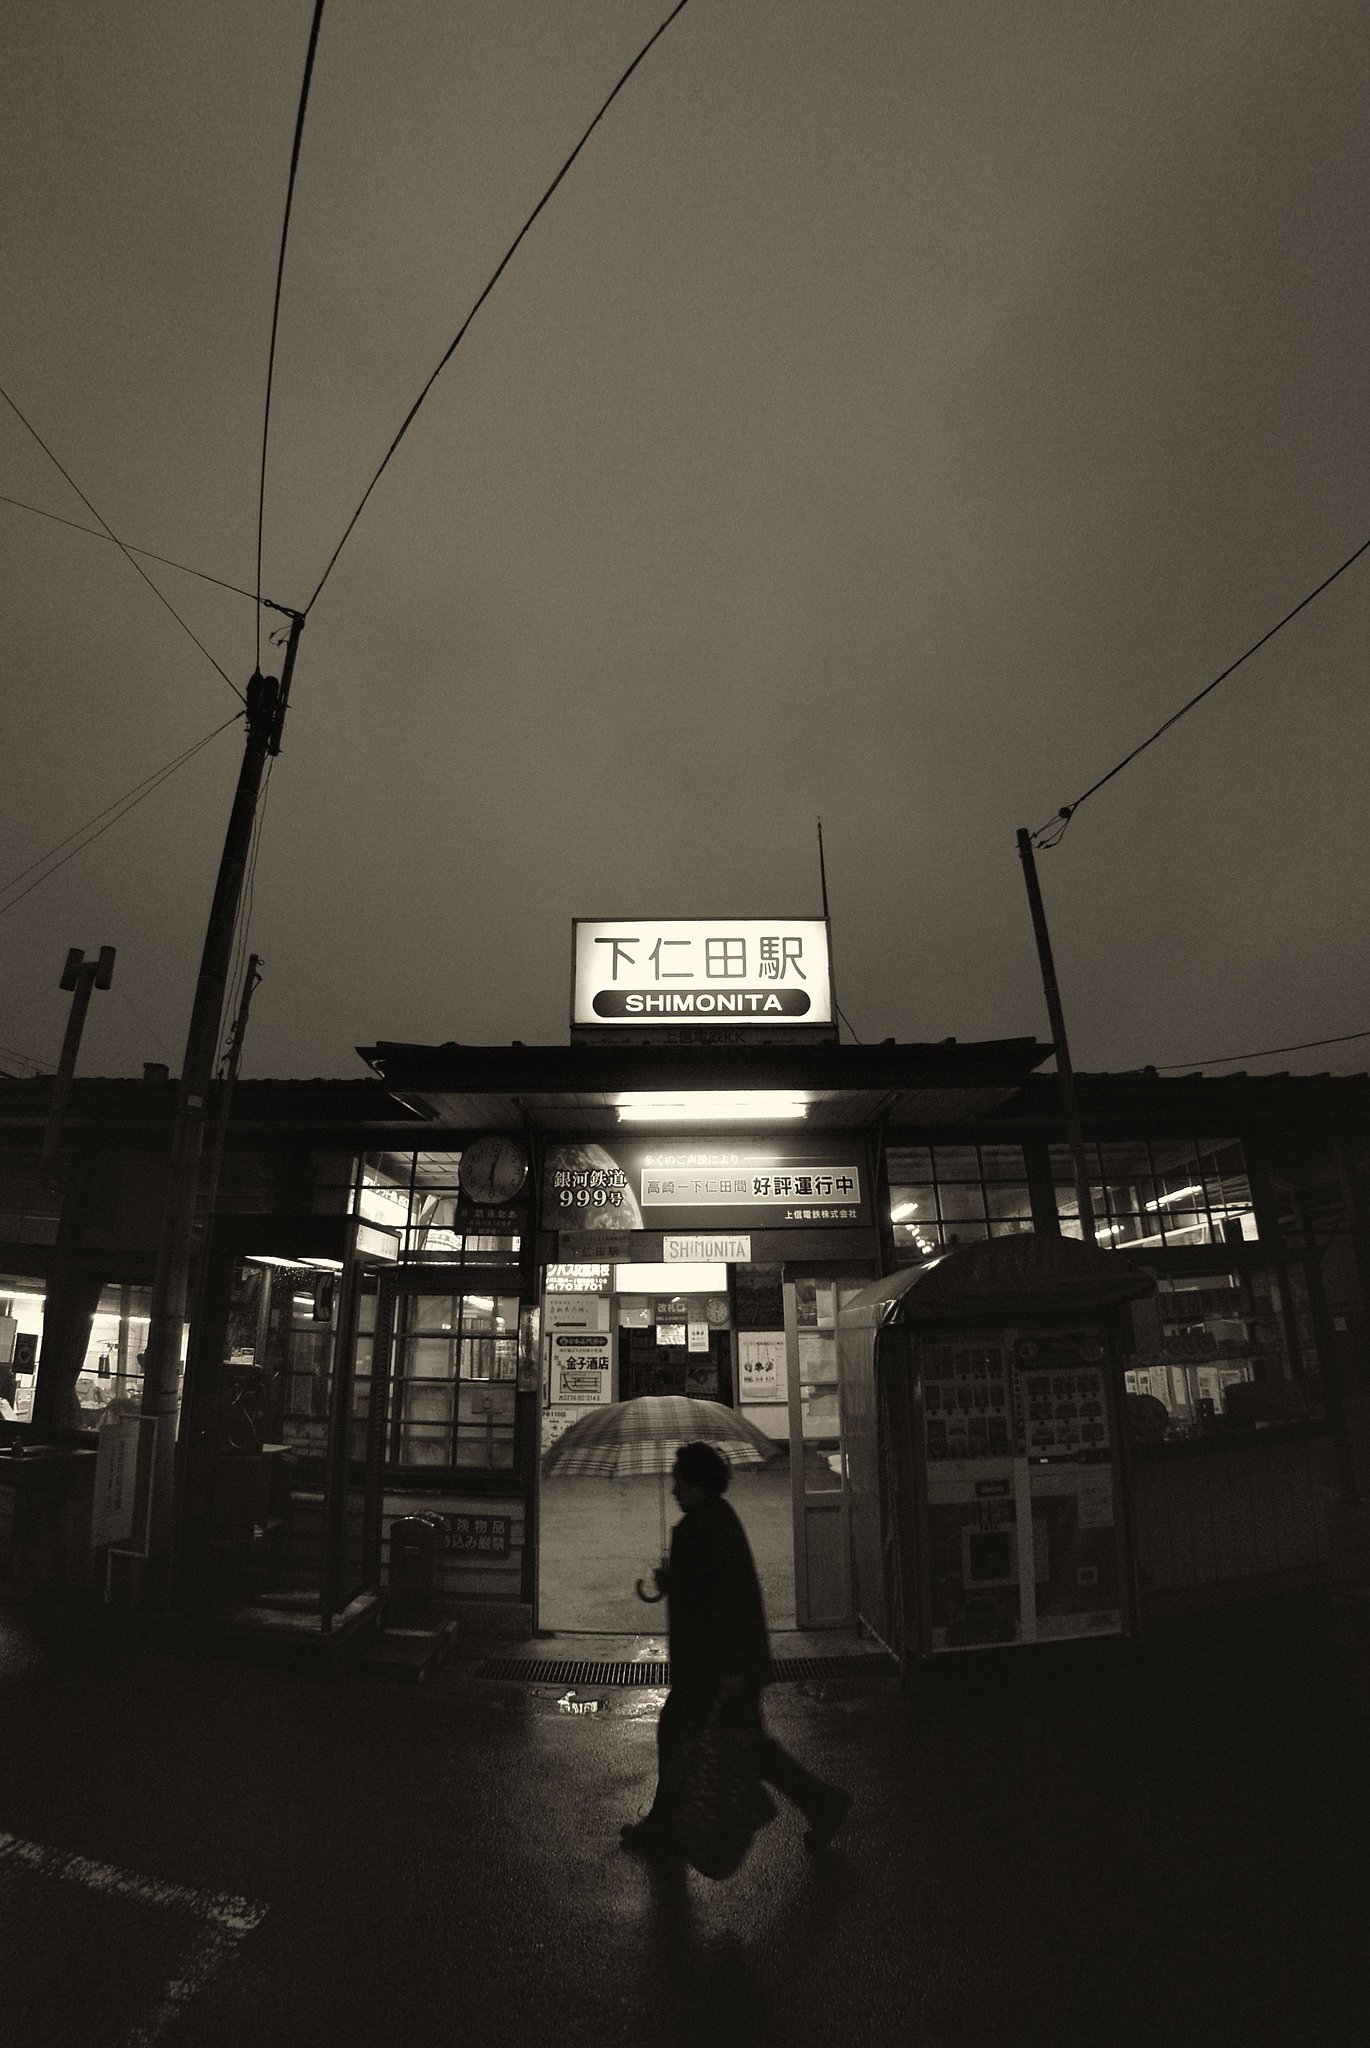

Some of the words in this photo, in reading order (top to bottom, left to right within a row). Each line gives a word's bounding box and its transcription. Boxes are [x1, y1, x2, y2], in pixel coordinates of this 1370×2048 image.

[594, 936, 807, 981] 下仁田駅
[625, 994, 783, 1012] SHIMONITA
[554, 1169, 627, 1188] 銀河鉄道
[752, 1175, 855, 1196] 好評運行中
[559, 1189, 624, 1207] 999号
[669, 1240, 746, 1259] SHIMONITA
[657, 1303, 686, 1312] 改札口
[566, 1355, 609, 1370] 金子酒店
